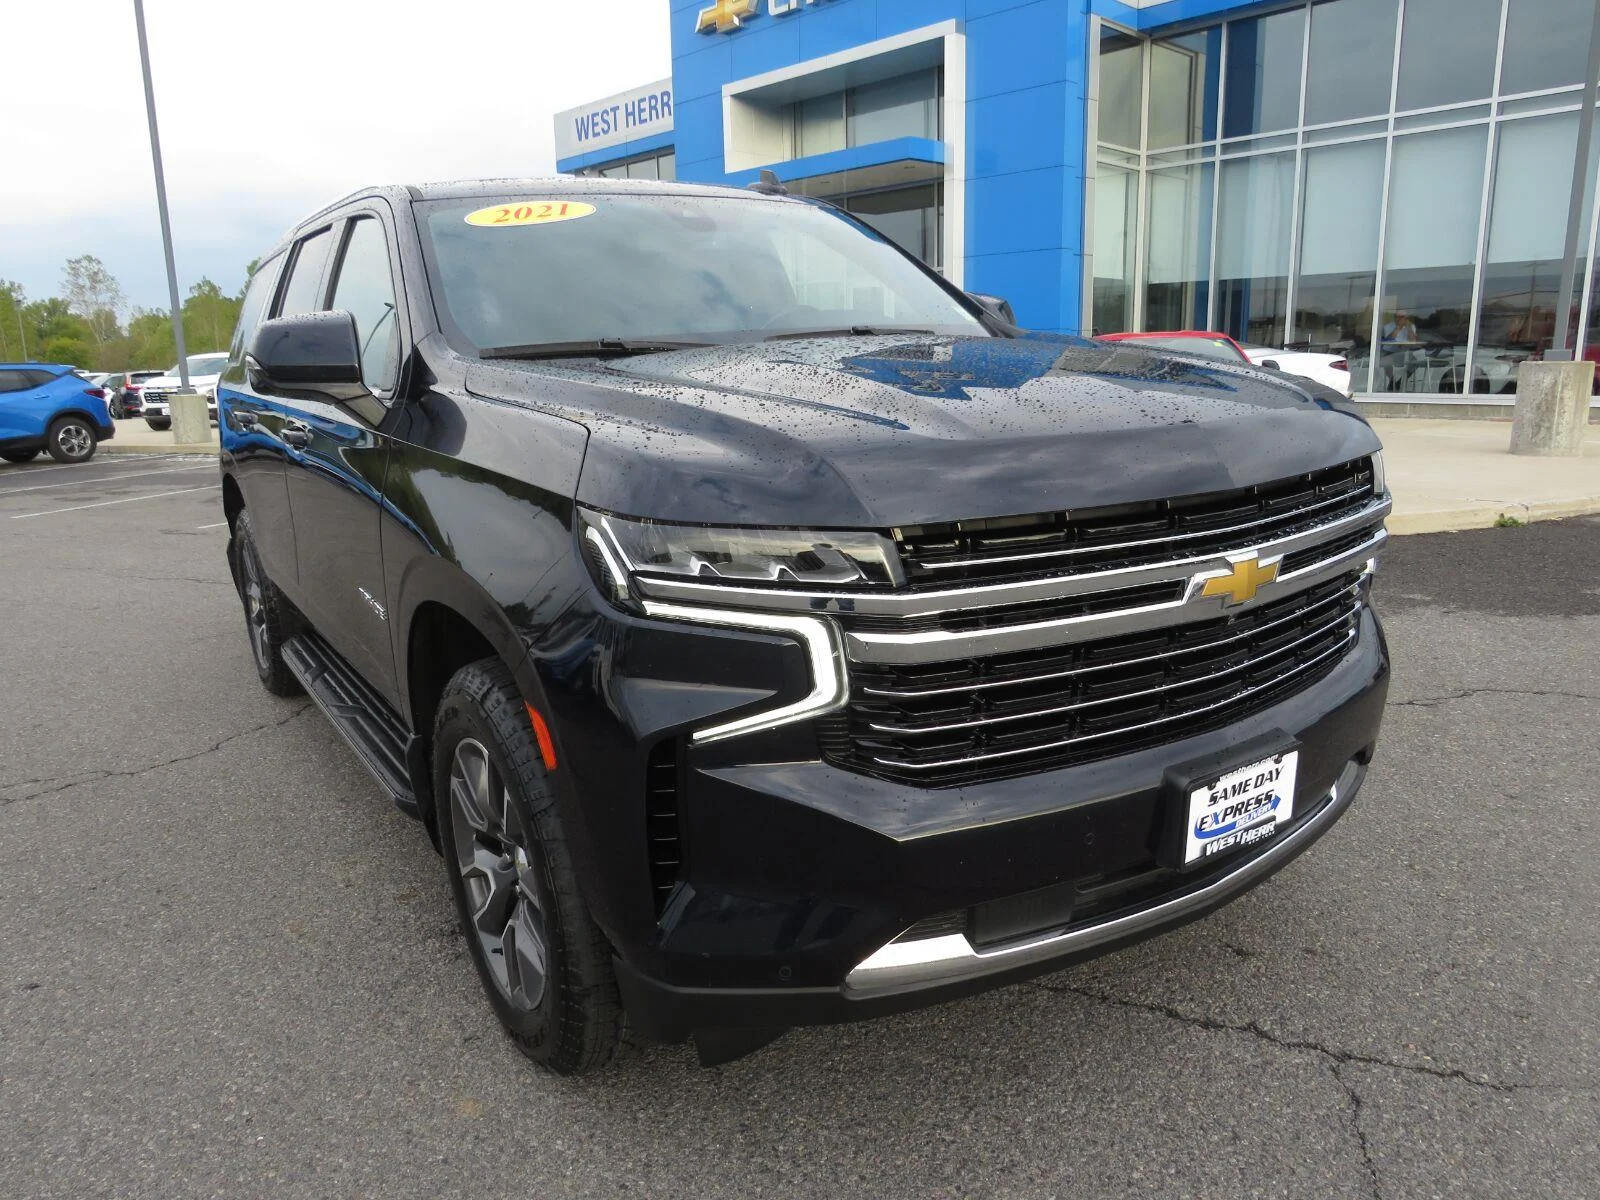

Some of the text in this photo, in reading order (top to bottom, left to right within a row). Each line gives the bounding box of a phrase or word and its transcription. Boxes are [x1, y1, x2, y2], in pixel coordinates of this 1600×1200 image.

[575, 90, 672, 142] WEST HERR
[494, 203, 568, 223] 2021
[1208, 765, 1285, 807] SAME DAY
[1199, 789, 1274, 831] EXPRESS
